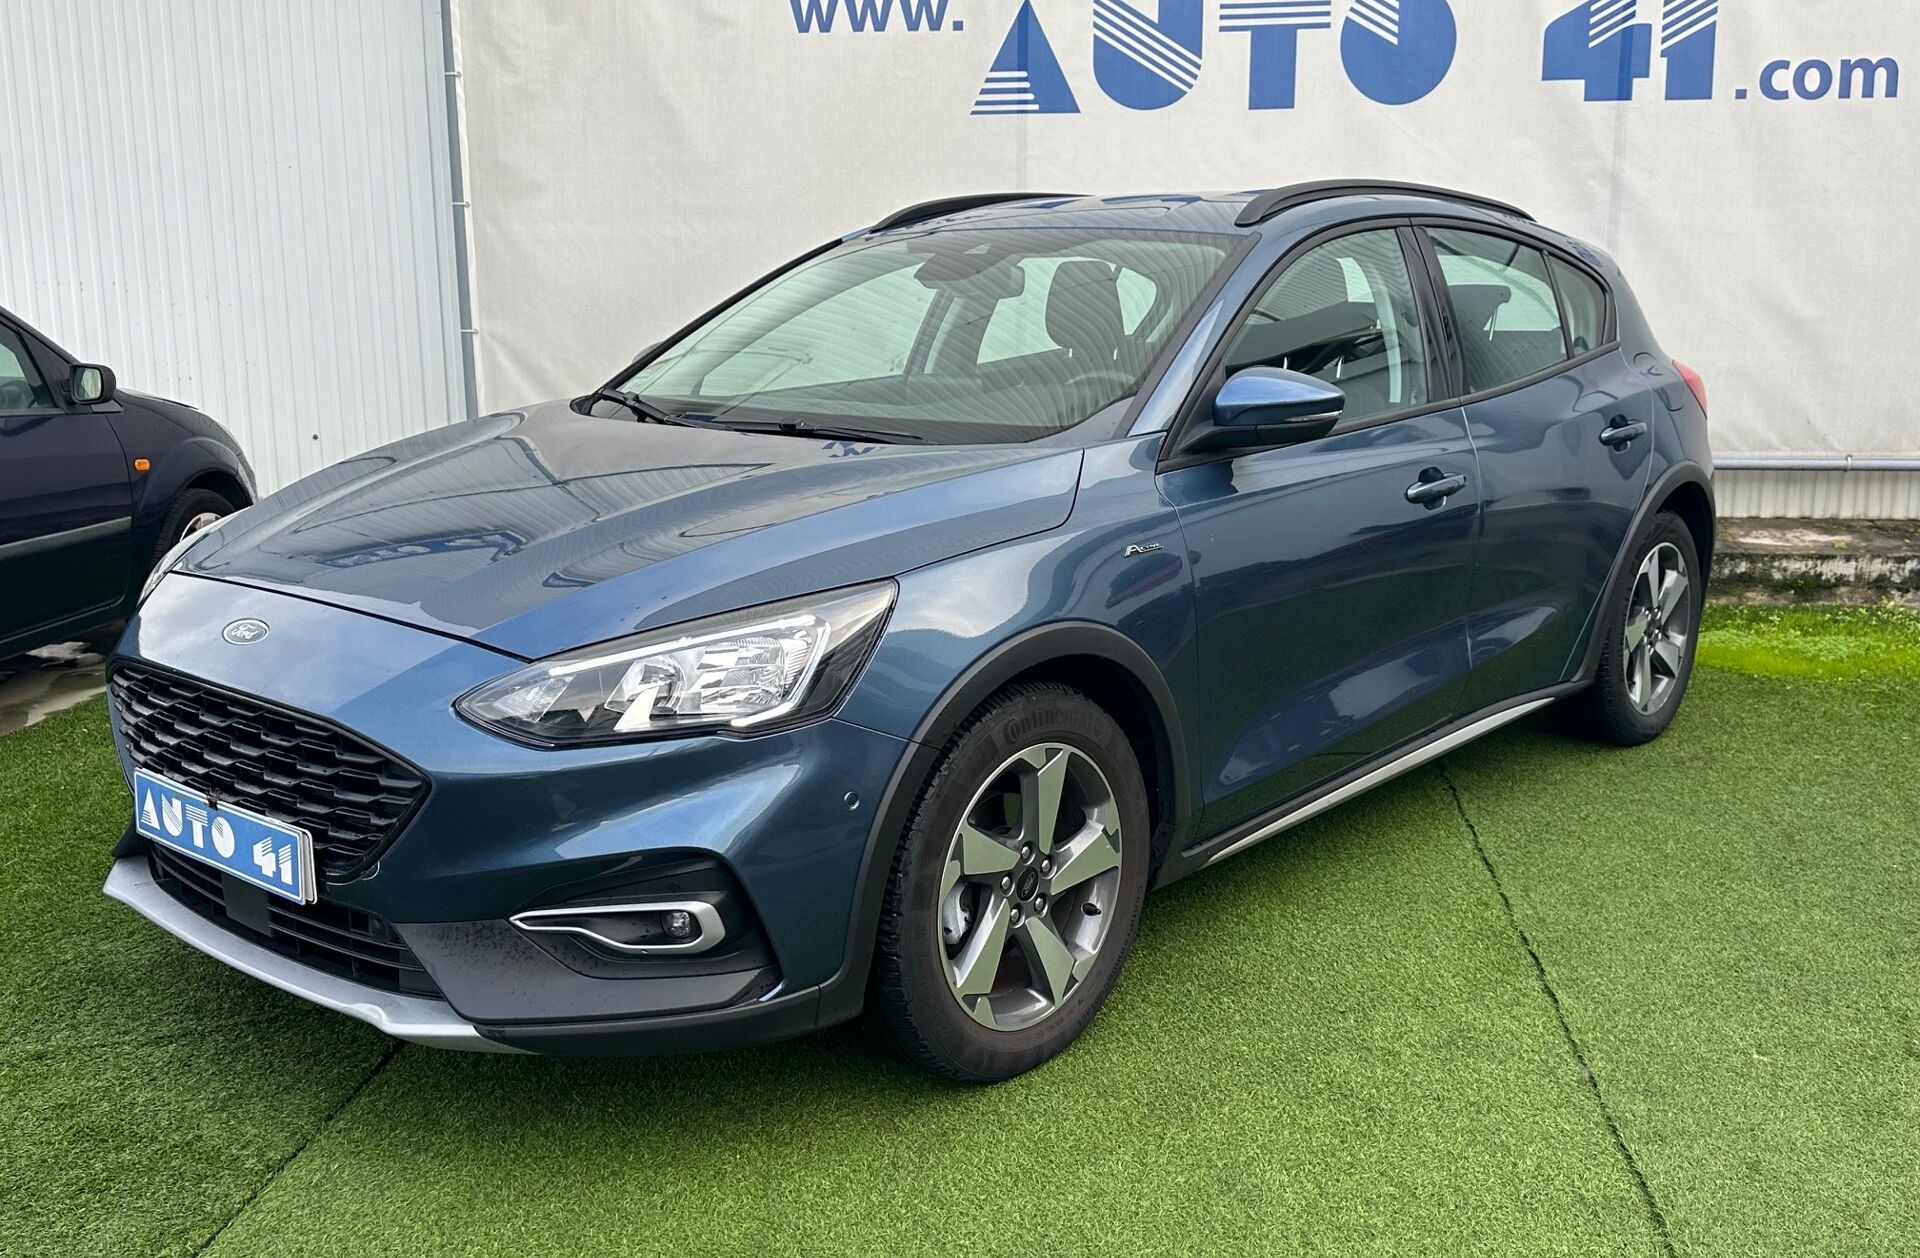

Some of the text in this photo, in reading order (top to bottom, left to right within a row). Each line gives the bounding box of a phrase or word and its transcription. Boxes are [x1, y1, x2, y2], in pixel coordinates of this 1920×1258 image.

[970, 0, 1456, 115] AUTO
[230, 623, 260, 640] Ford
[141, 787, 293, 885] AUTO 41
